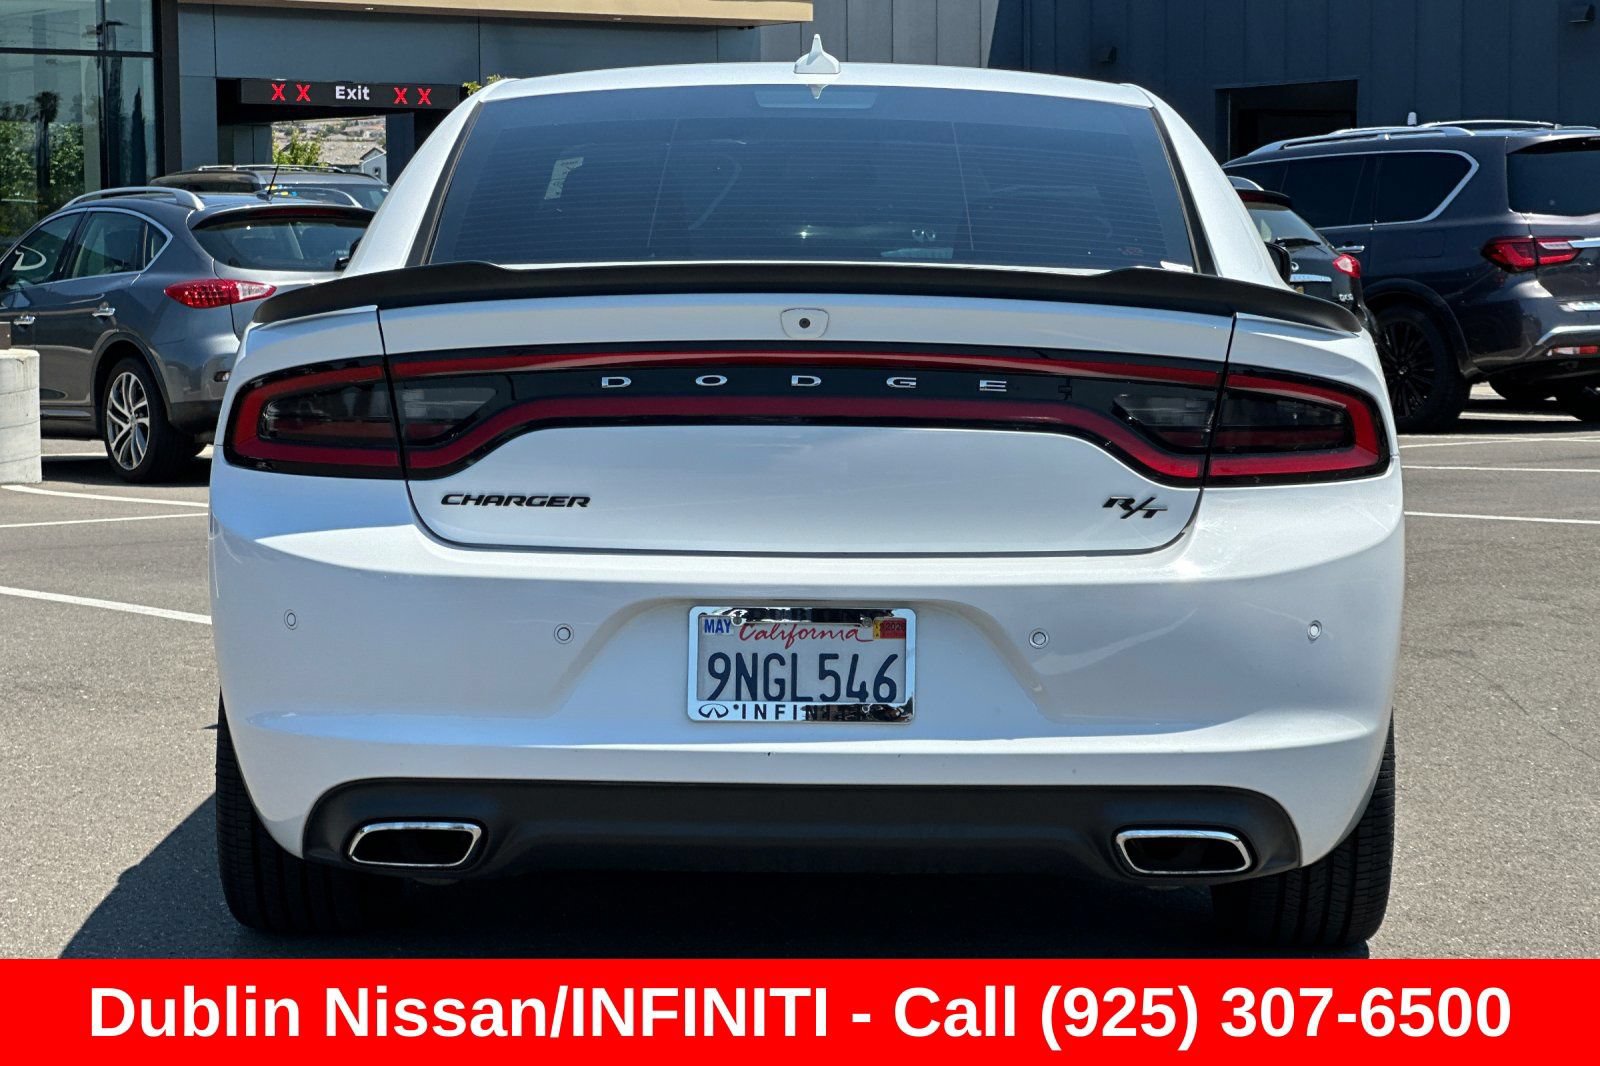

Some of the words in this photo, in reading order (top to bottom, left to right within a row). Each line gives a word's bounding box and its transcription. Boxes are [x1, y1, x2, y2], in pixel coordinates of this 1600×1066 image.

[335, 85, 370, 101] Exit
[601, 374, 1008, 393] DODGE
[440, 494, 592, 508] CHARGER
[1102, 496, 1169, 519] R/T
[704, 619, 732, 634] MAY
[739, 622, 874, 649] California
[707, 652, 899, 703] 9NGL546
